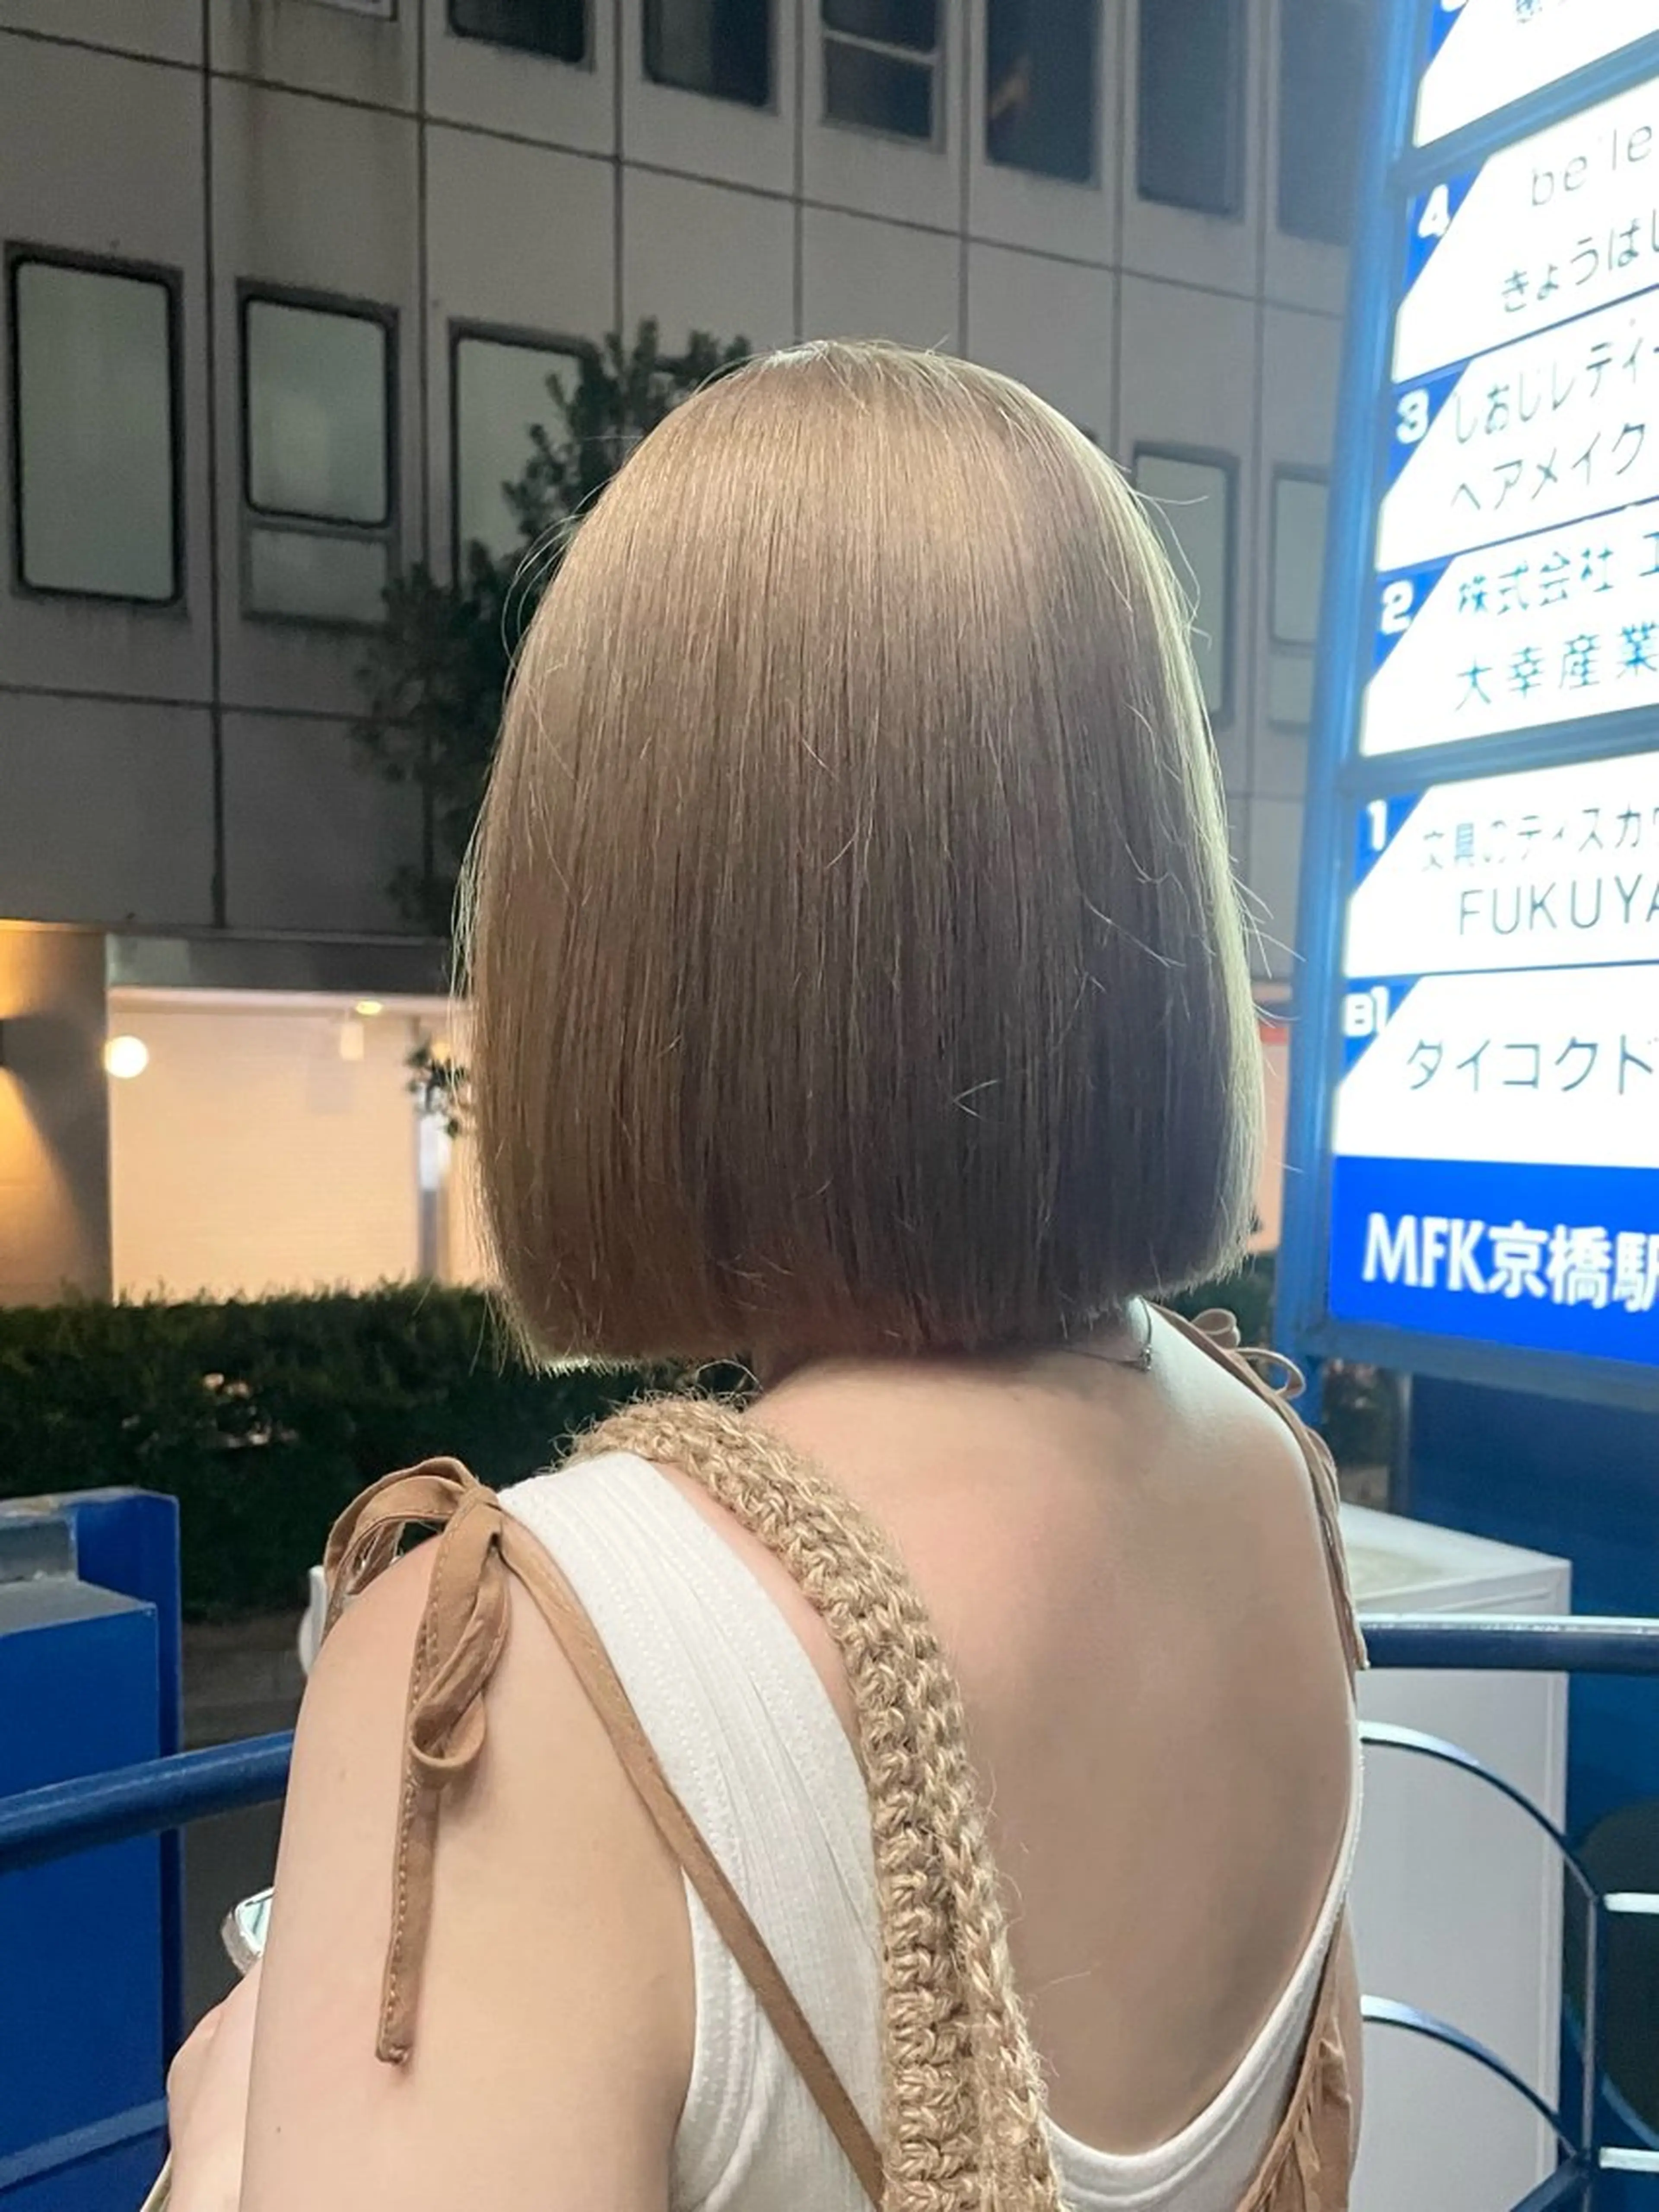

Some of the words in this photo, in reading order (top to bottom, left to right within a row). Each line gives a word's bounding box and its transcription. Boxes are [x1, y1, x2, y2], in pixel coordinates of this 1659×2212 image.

[1420, 184, 1449, 237] 4
[1397, 390, 1428, 443] 3
[1456, 543, 1615, 615] 株式会社
[1381, 580, 1414, 634] 2
[1345, 986, 1390, 1035] B1
[1362, 1212, 1659, 1312] MFK京橋駅
